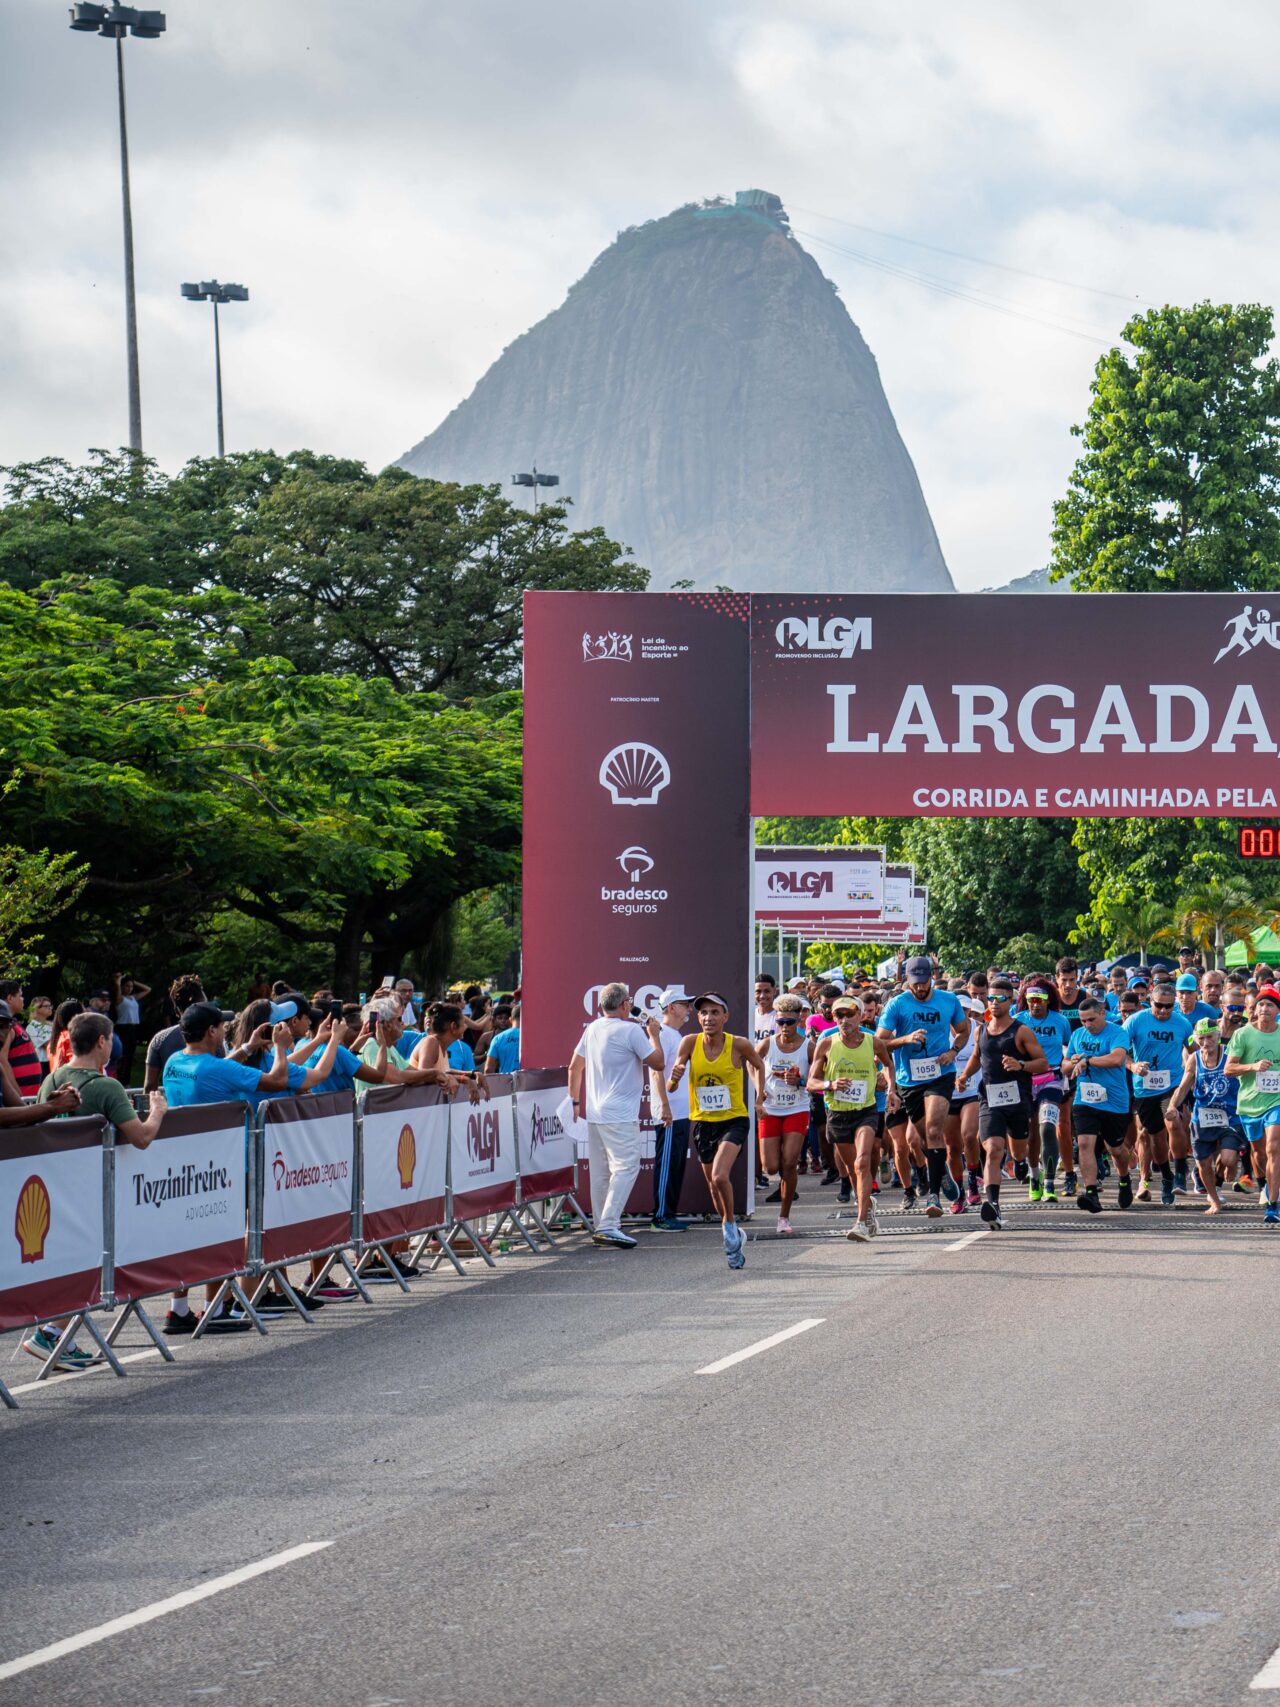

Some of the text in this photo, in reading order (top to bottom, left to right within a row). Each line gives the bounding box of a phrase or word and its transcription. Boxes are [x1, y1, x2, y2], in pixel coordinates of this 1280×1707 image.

[912, 787, 1028, 808] CORRIDA
[1036, 788, 1048, 808] E
[1054, 787, 1210, 808] CAMINHADA
[601, 886, 668, 901] bradesco
[611, 904, 658, 916] seguros
[916, 1064, 936, 1074] 1058
[702, 1093, 724, 1105] 1017
[998, 1091, 1009, 1099] 43
[1086, 1090, 1099, 1098] 461
[285, 1160, 348, 1190] bradesco seguros
[185, 1200, 228, 1221] ADVOGADOS
